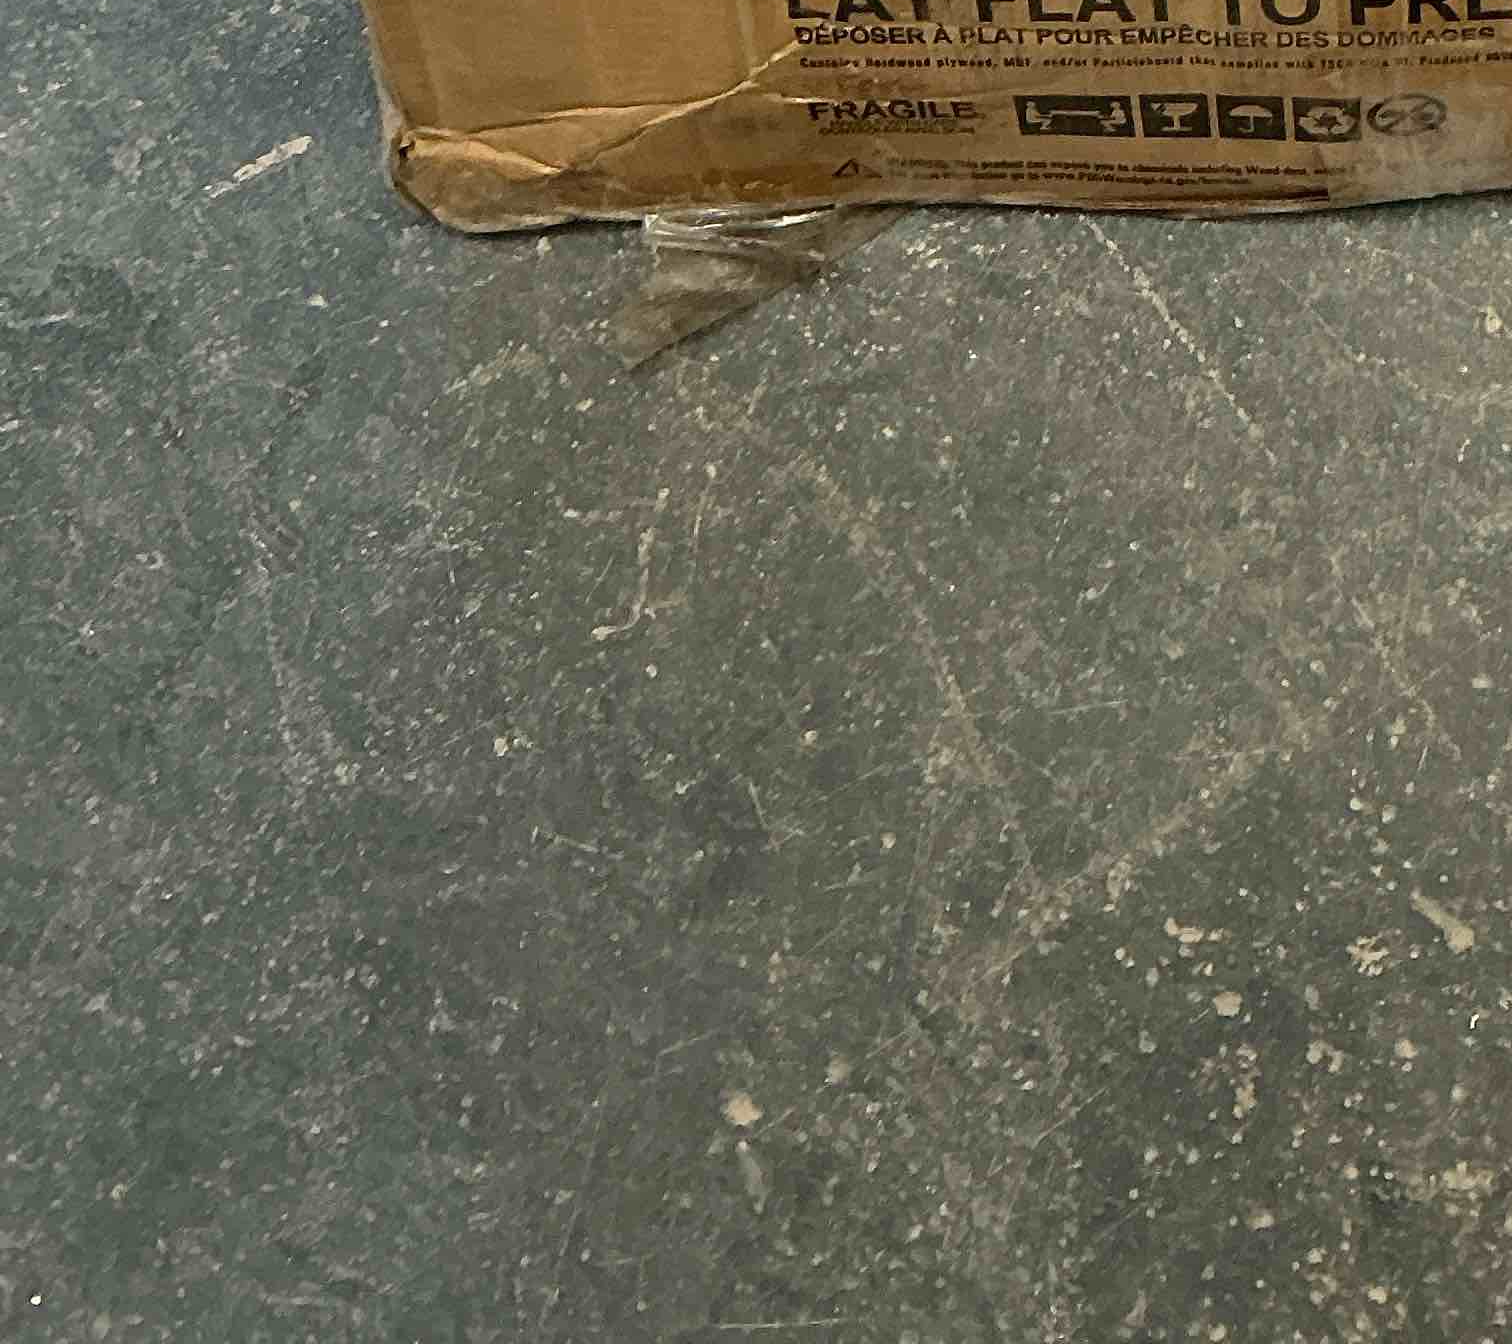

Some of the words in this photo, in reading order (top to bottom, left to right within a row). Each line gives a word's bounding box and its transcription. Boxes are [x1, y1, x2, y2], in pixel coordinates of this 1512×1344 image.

[795, 23, 926, 45] DÉPOSER
[932, 22, 953, 45] À
[959, 25, 1027, 45] PLAT
[1036, 26, 1113, 46] POUR
[1121, 22, 1268, 49] EMPÊCHER
[1277, 29, 1329, 49] DES
[1336, 25, 1496, 49] DOMMAGES
[807, 99, 977, 121] FRAGILE
